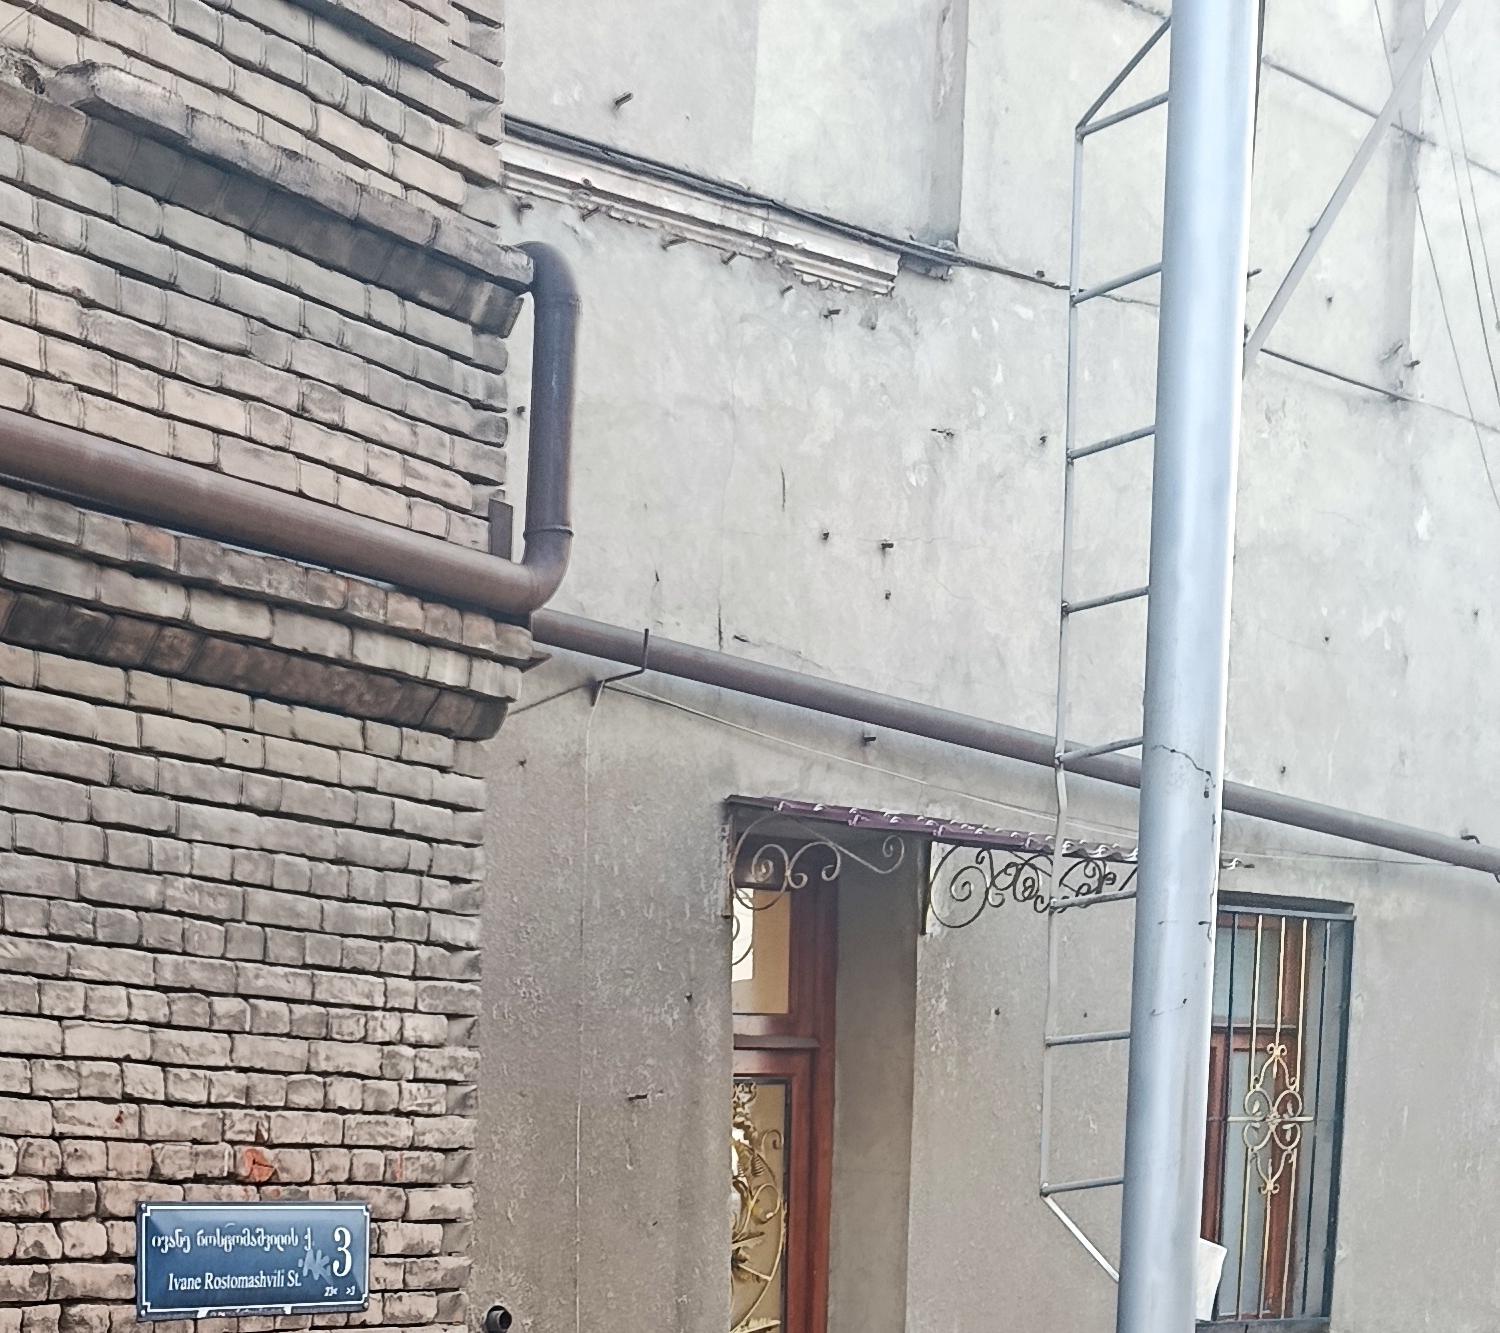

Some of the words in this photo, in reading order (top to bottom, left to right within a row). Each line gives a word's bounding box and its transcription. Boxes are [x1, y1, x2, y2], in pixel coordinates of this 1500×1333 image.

[151, 1228, 191, 1254] ივანე
[332, 1227, 352, 1277] 3
[168, 1273, 201, 1291] Ivane
[204, 1269, 285, 1290] Rostomashvili
[287, 1270, 302, 1288] St.
